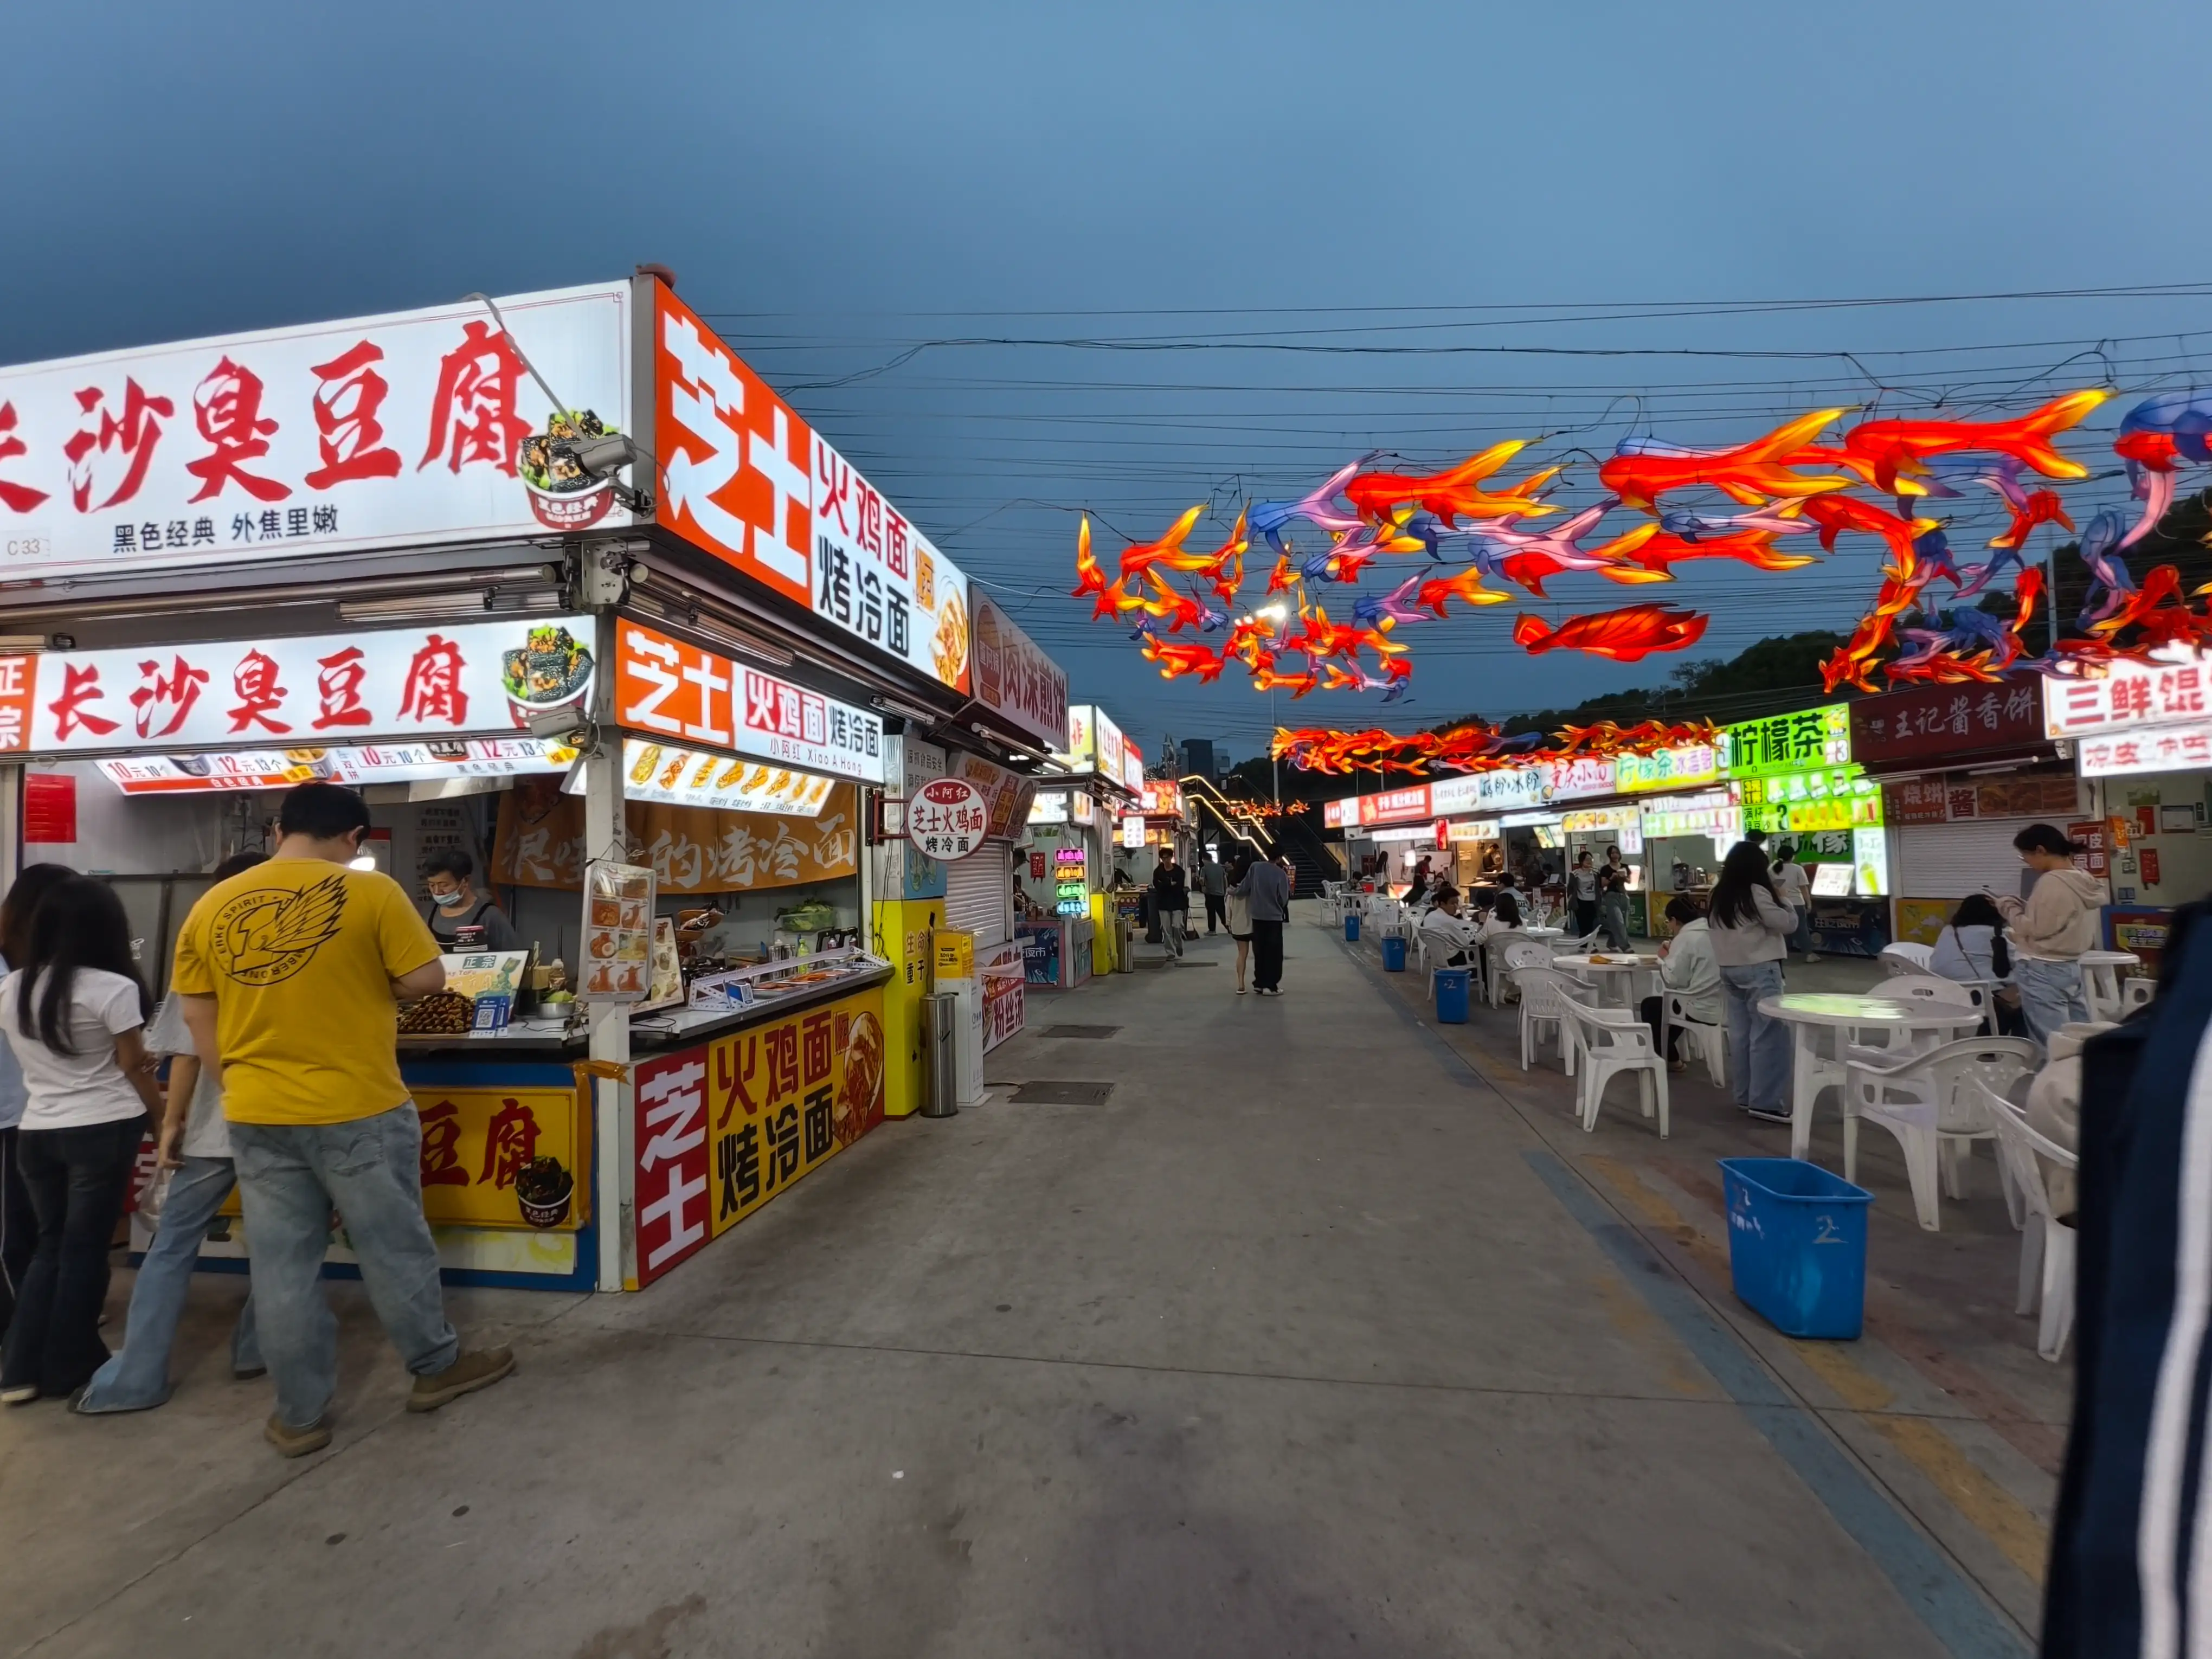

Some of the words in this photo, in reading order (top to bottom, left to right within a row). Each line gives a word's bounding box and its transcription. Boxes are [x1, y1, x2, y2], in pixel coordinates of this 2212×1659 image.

[664, 310, 811, 587] 芝士
[113, 515, 216, 554] 黑色经典
[232, 504, 339, 543] 外焦里嫩
[818, 440, 909, 581] 火鸡面
[818, 535, 910, 658] 烤冷面
[0, 660, 26, 749] 正宗
[48, 634, 470, 743] 长沙臭豆腐
[626, 630, 729, 745] 芝士
[748, 672, 824, 745] 火鸡面
[829, 704, 879, 758] 烤冷面
[770, 737, 801, 761] 小阿红
[808, 748, 829, 765] Xiao
[841, 756, 862, 776] Hong
[1731, 712, 1824, 769] 柠檬茶
[913, 804, 983, 834] 芝士火鸡面
[926, 787, 969, 800] 小阿红
[925, 836, 969, 853] 烤冷面
[223, 895, 266, 920] SPIRIT
[463, 955, 496, 969] 正宗
[717, 1010, 832, 1131] 火鸡面
[640, 1061, 706, 1270] 芝士
[717, 1083, 834, 1223] 烤冷面
